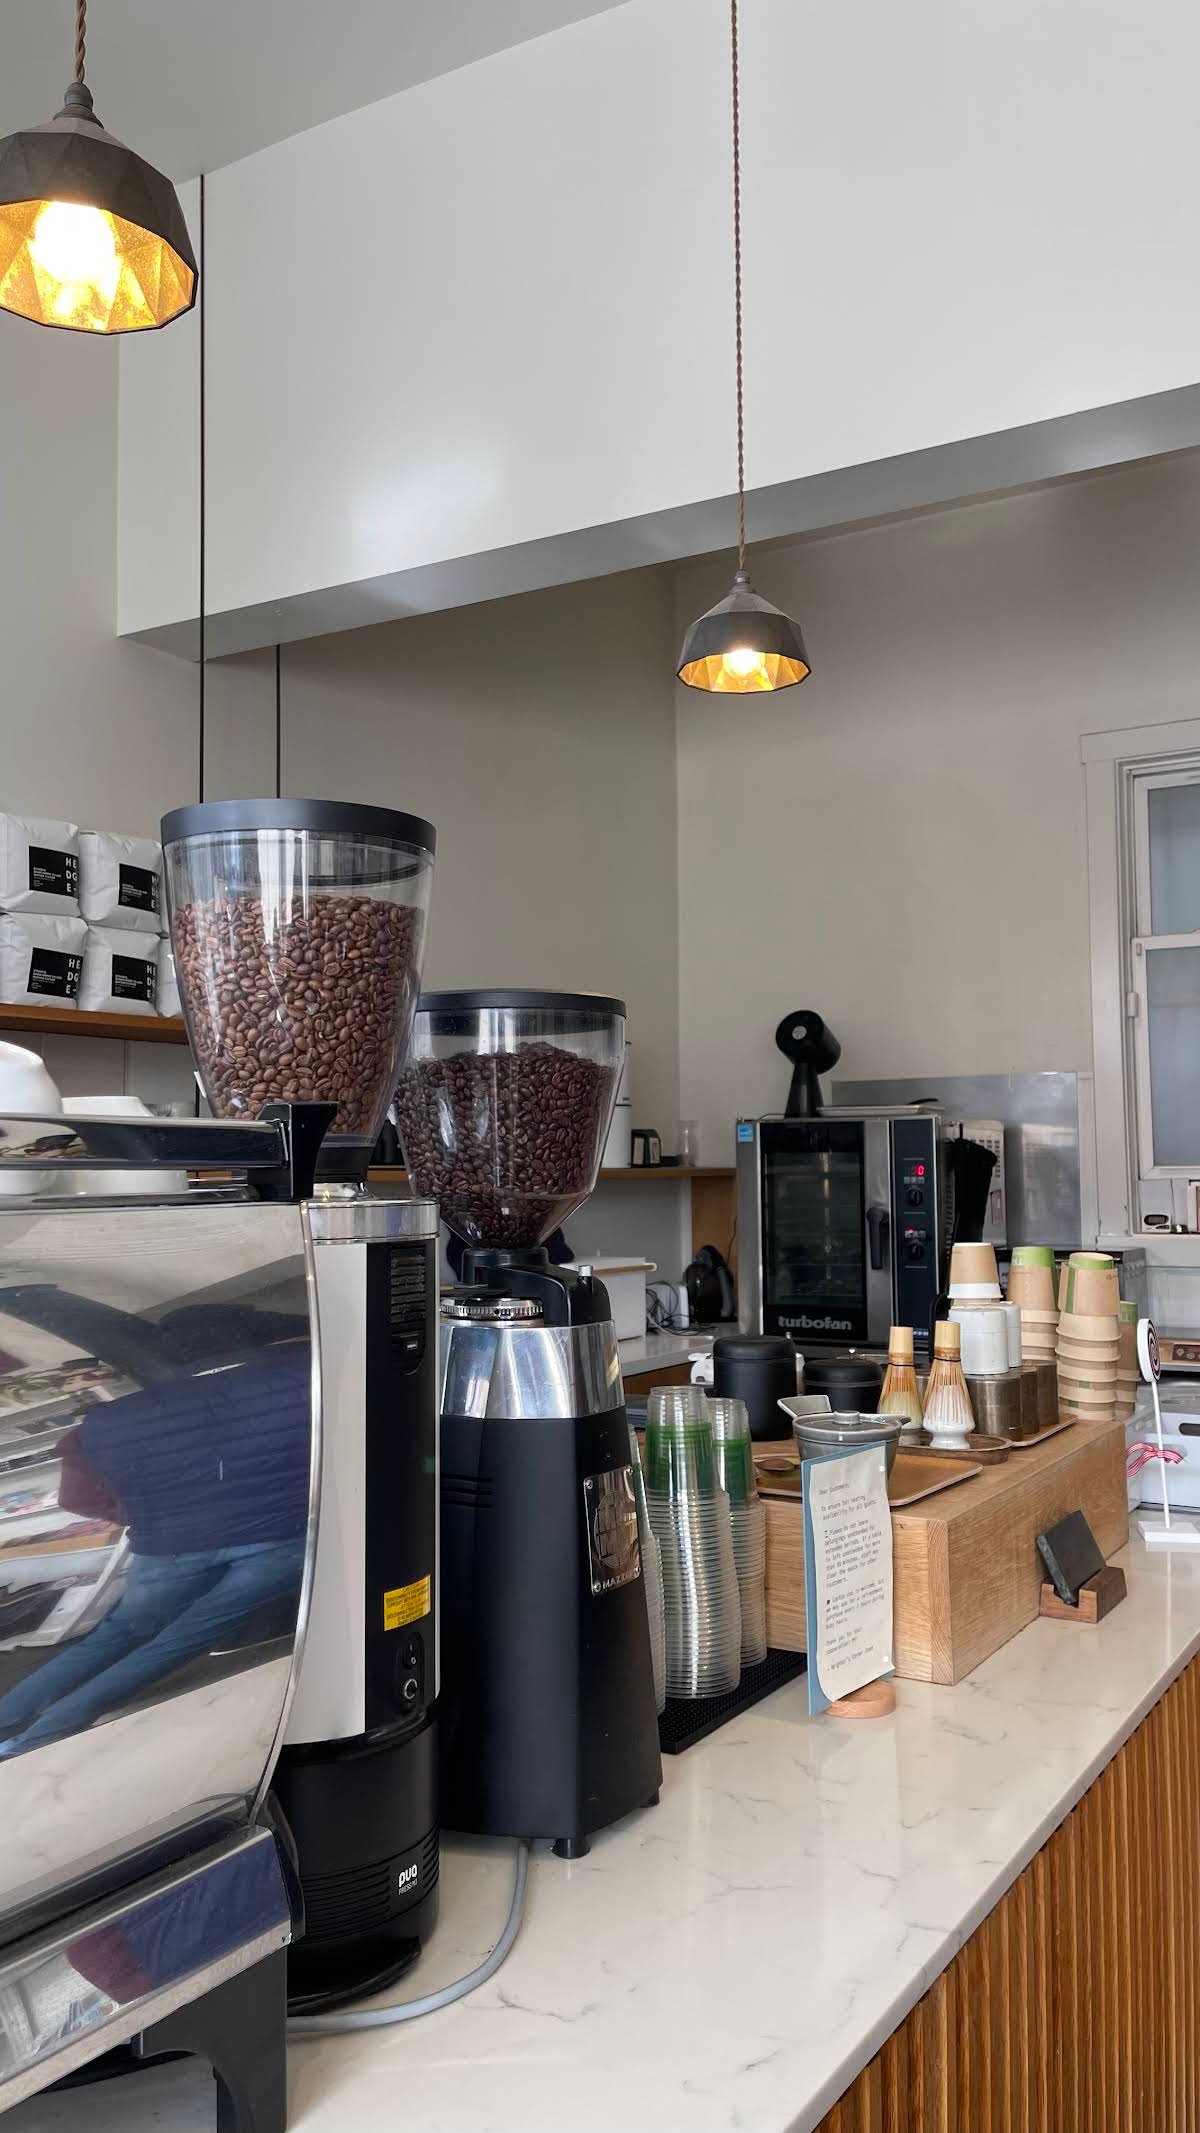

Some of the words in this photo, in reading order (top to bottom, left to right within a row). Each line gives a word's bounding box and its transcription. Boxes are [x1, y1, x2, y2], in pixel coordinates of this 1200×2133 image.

[68, 959, 81, 970] HE
[67, 971, 79, 982] DG
[778, 1315, 852, 1330] turbofan
